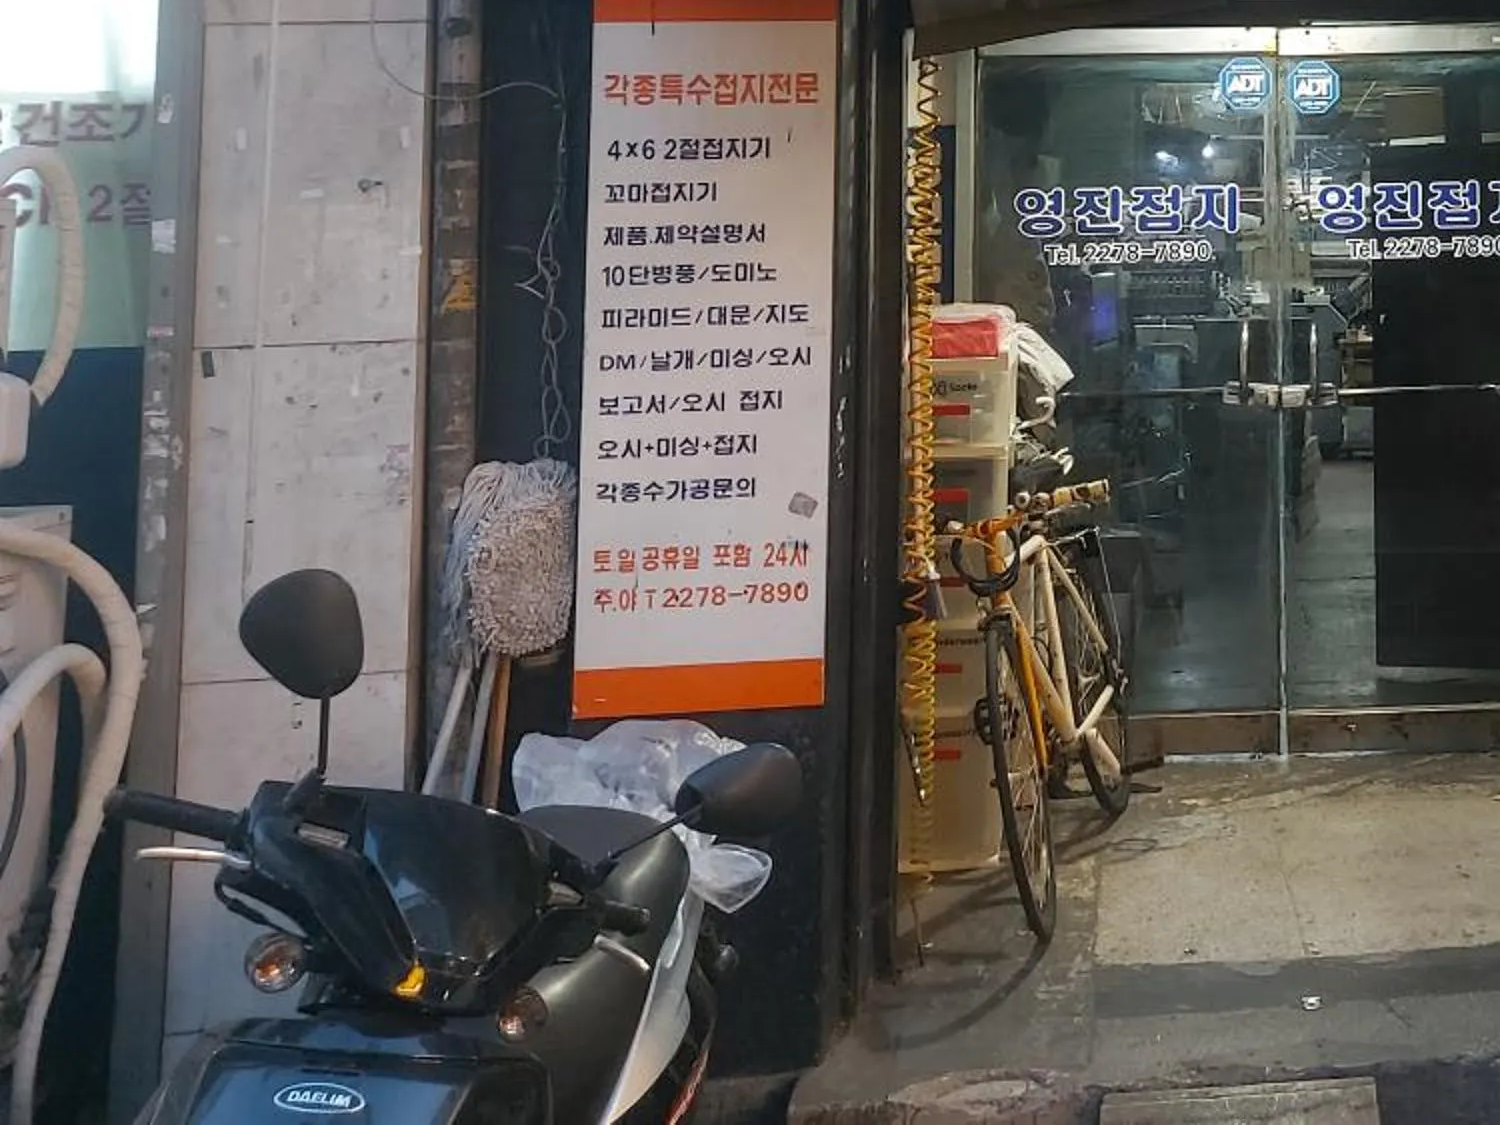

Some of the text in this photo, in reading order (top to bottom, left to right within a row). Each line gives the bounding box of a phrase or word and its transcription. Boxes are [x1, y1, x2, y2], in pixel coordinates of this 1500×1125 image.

[603, 73, 820, 106] 각종특수접지전문
[1227, 74, 1265, 94] ADT
[1294, 78, 1331, 99] ADT
[664, 136, 771, 161] 2절접지기
[604, 182, 718, 204] 꼬마접지기
[1014, 183, 1240, 237] 영진접지
[740, 390, 782, 412] 접지
[596, 477, 755, 503] 각종수가공문의
[642, 546, 699, 572] 공휴일
[713, 542, 751, 568] 포함
[662, 580, 810, 609] 2278-7890
[286, 1090, 352, 1107] DAELIM
